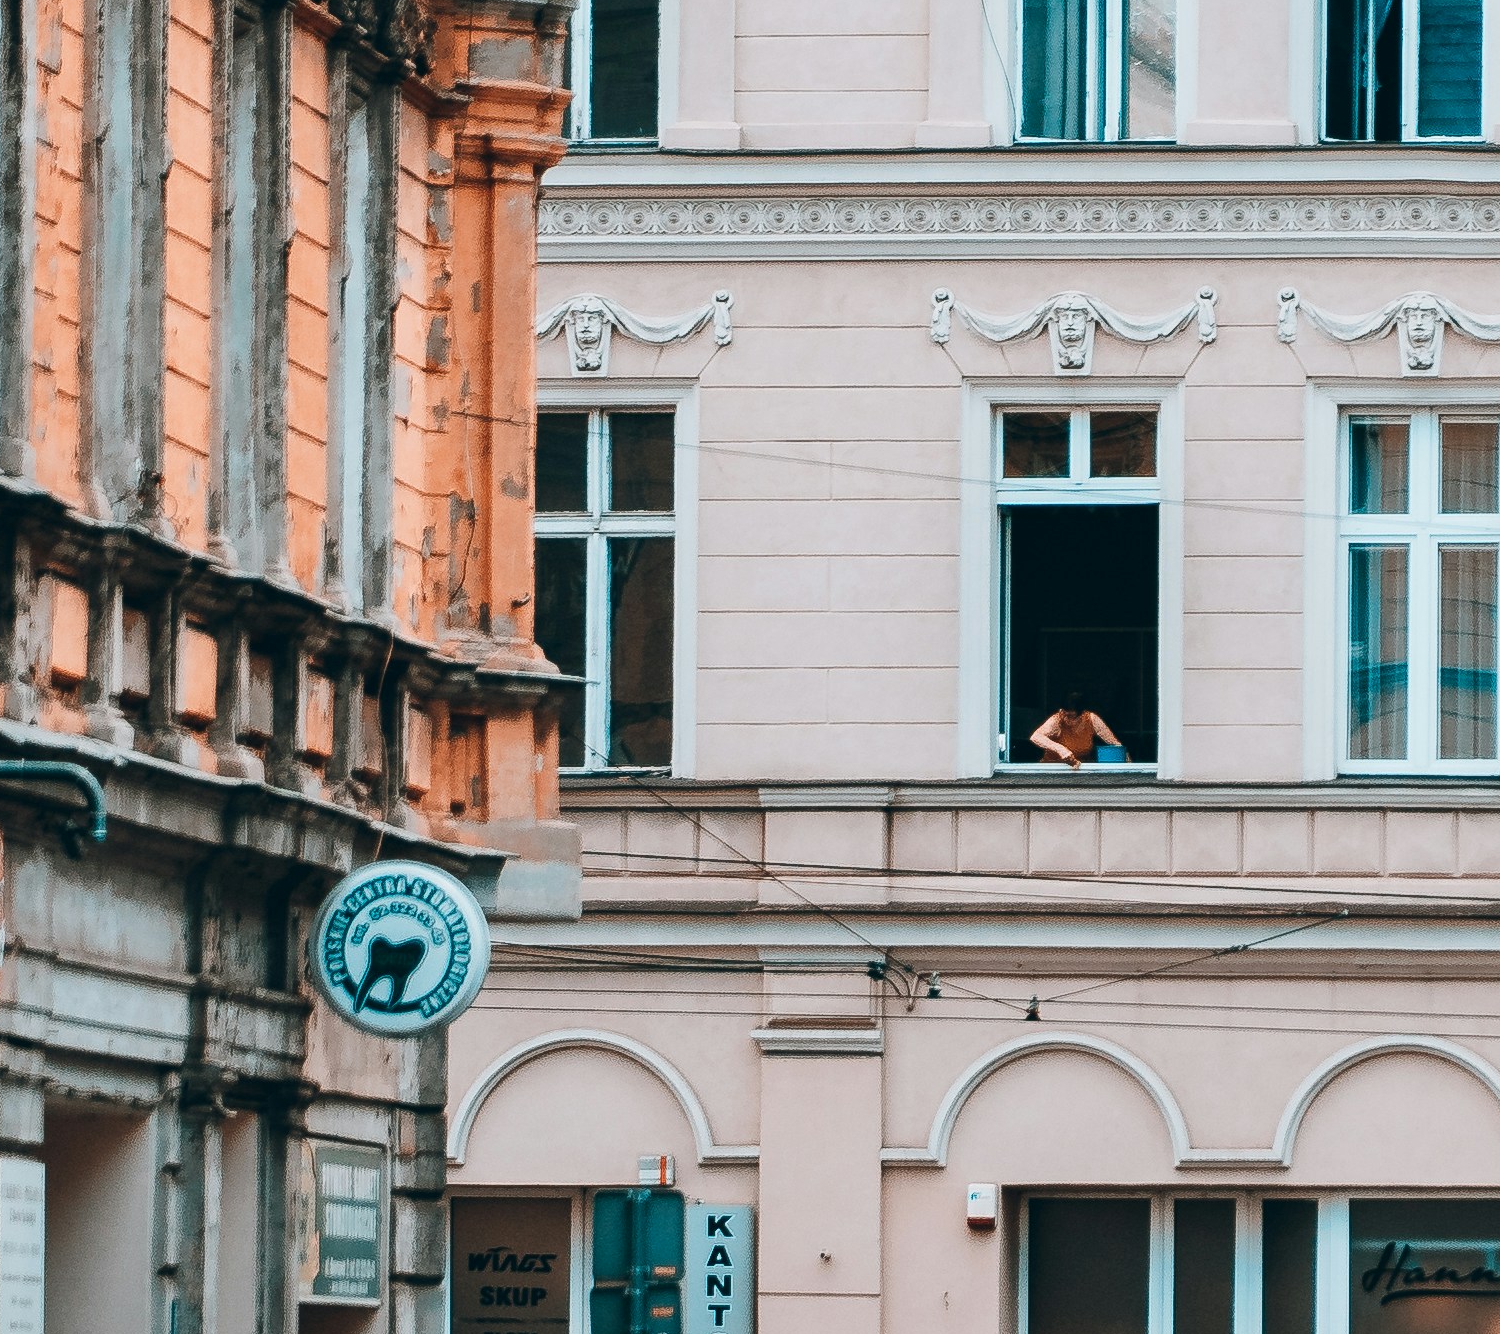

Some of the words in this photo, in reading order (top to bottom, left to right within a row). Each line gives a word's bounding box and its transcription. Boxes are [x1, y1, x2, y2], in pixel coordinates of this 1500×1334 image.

[324, 908, 349, 987] POLSKIE
[342, 875, 409, 910] CENTRA
[479, 1285, 548, 1307] SKUP
